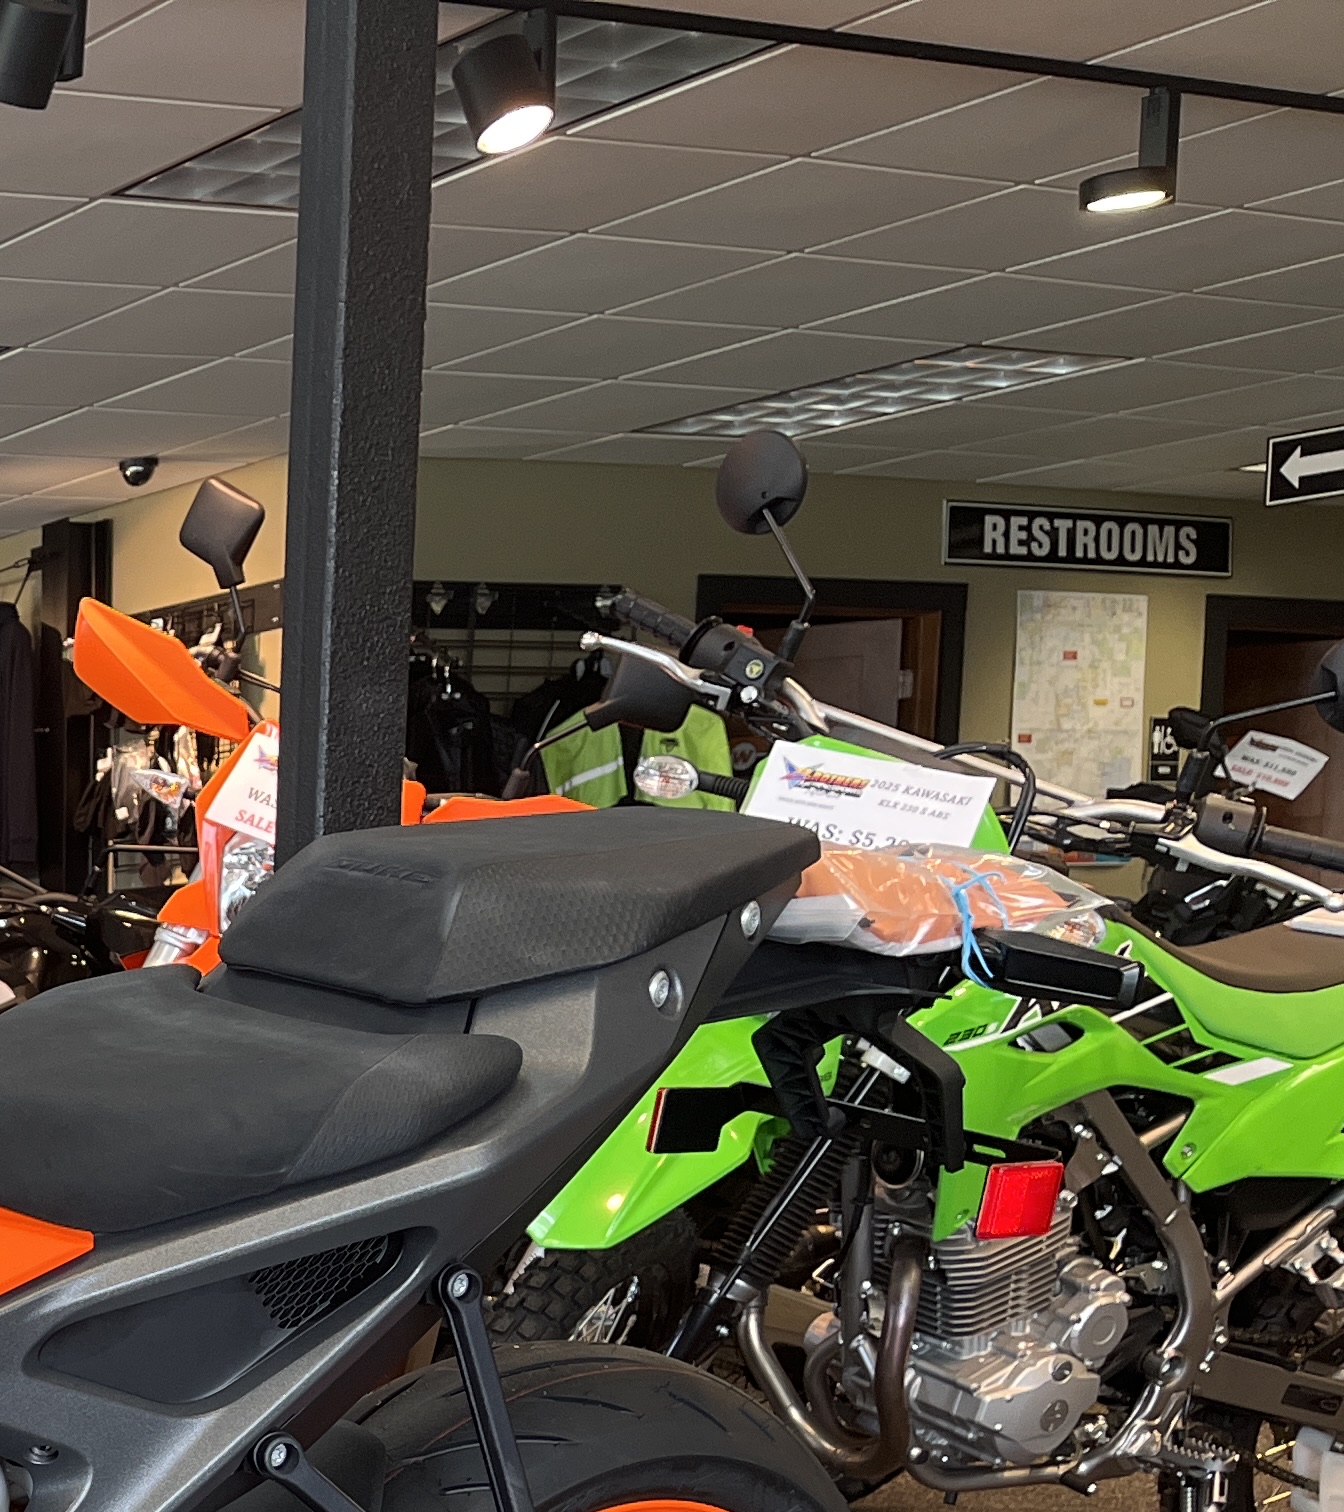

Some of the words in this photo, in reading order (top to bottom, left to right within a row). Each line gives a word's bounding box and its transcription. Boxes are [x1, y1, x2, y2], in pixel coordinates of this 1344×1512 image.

[983, 514, 1197, 565] RESTROOMS
[870, 779, 902, 793] 2025
[901, 783, 974, 806] KAWASAKI
